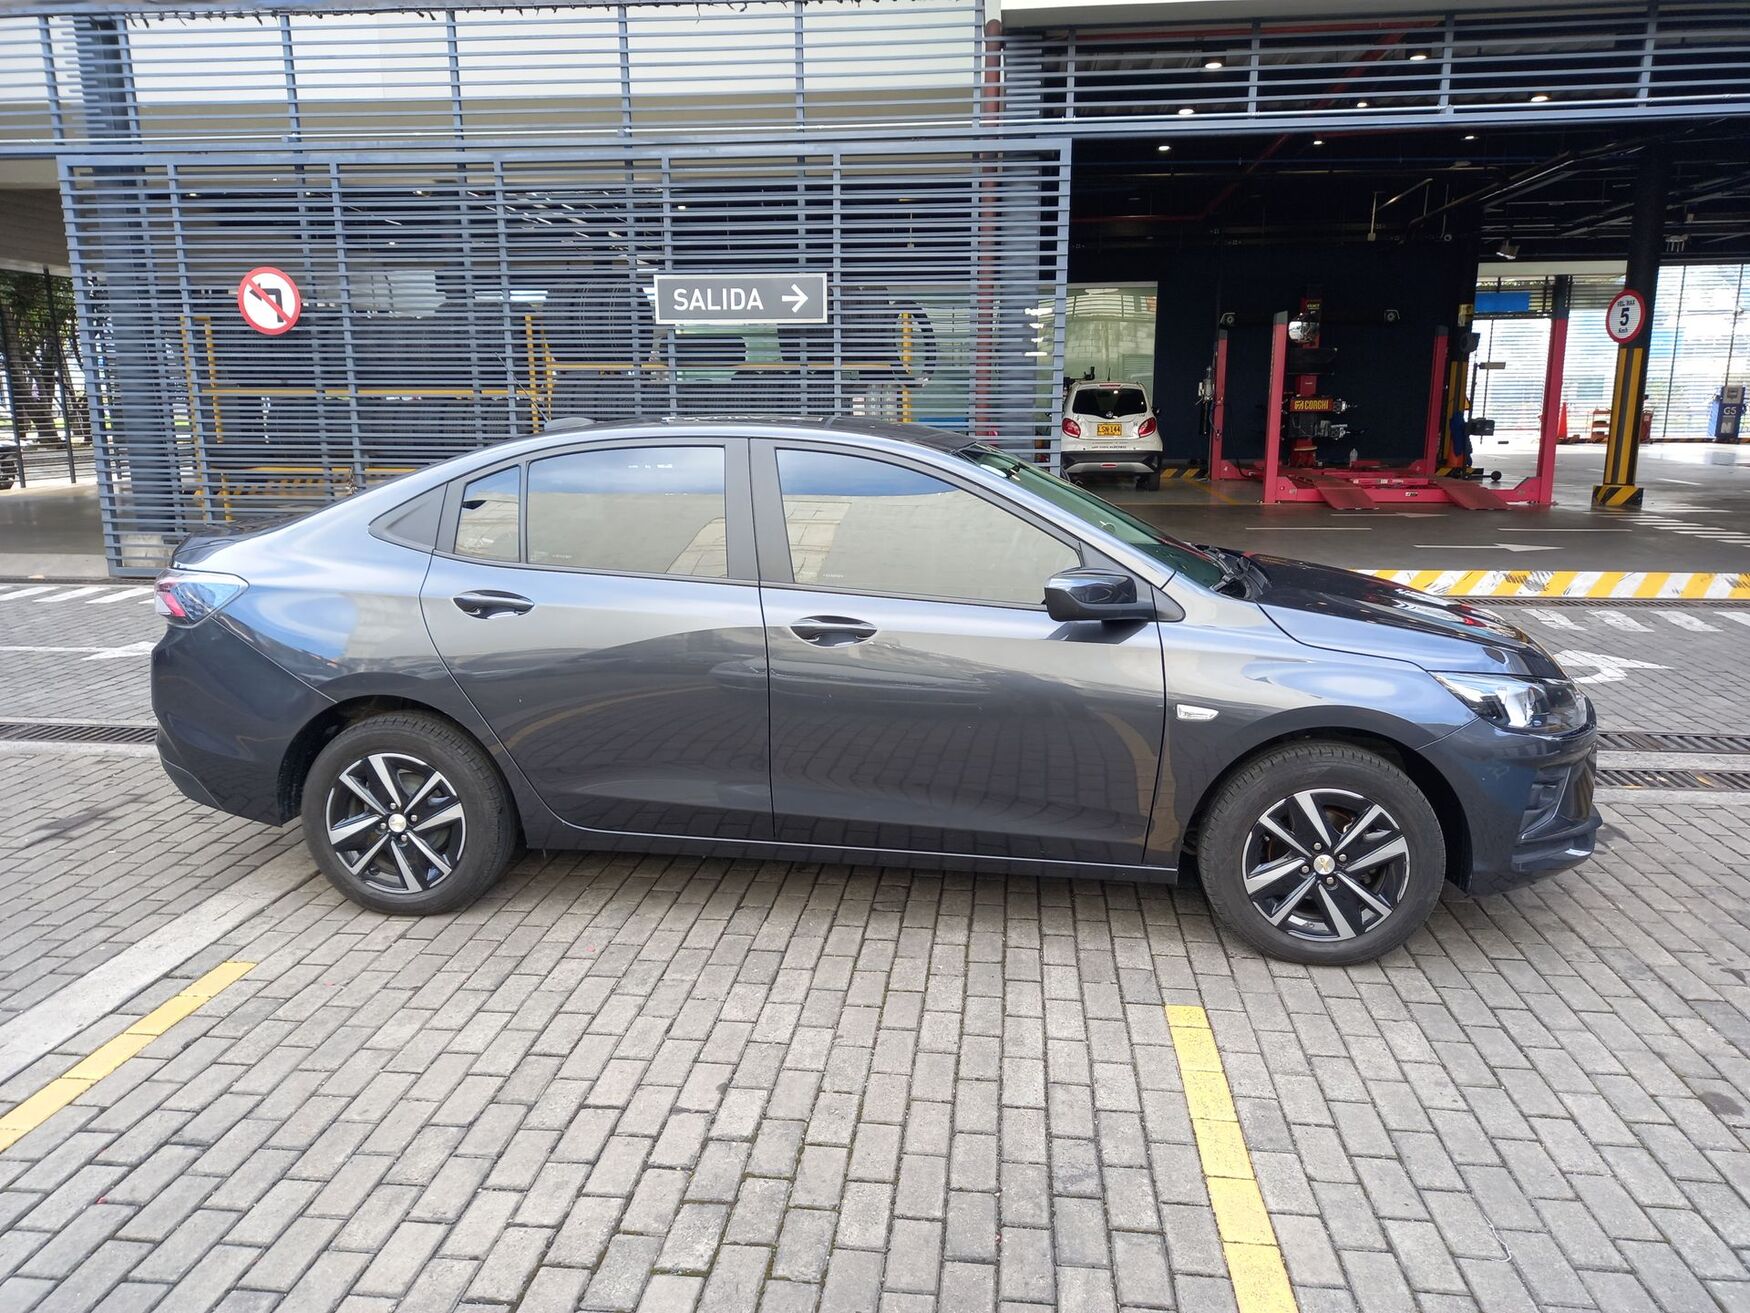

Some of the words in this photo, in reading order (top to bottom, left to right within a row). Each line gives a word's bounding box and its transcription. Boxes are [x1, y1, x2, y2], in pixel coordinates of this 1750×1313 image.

[673, 287, 764, 311] SALIDA
[1620, 307, 1630, 326] 5
[1304, 399, 1329, 410] CORGHI
